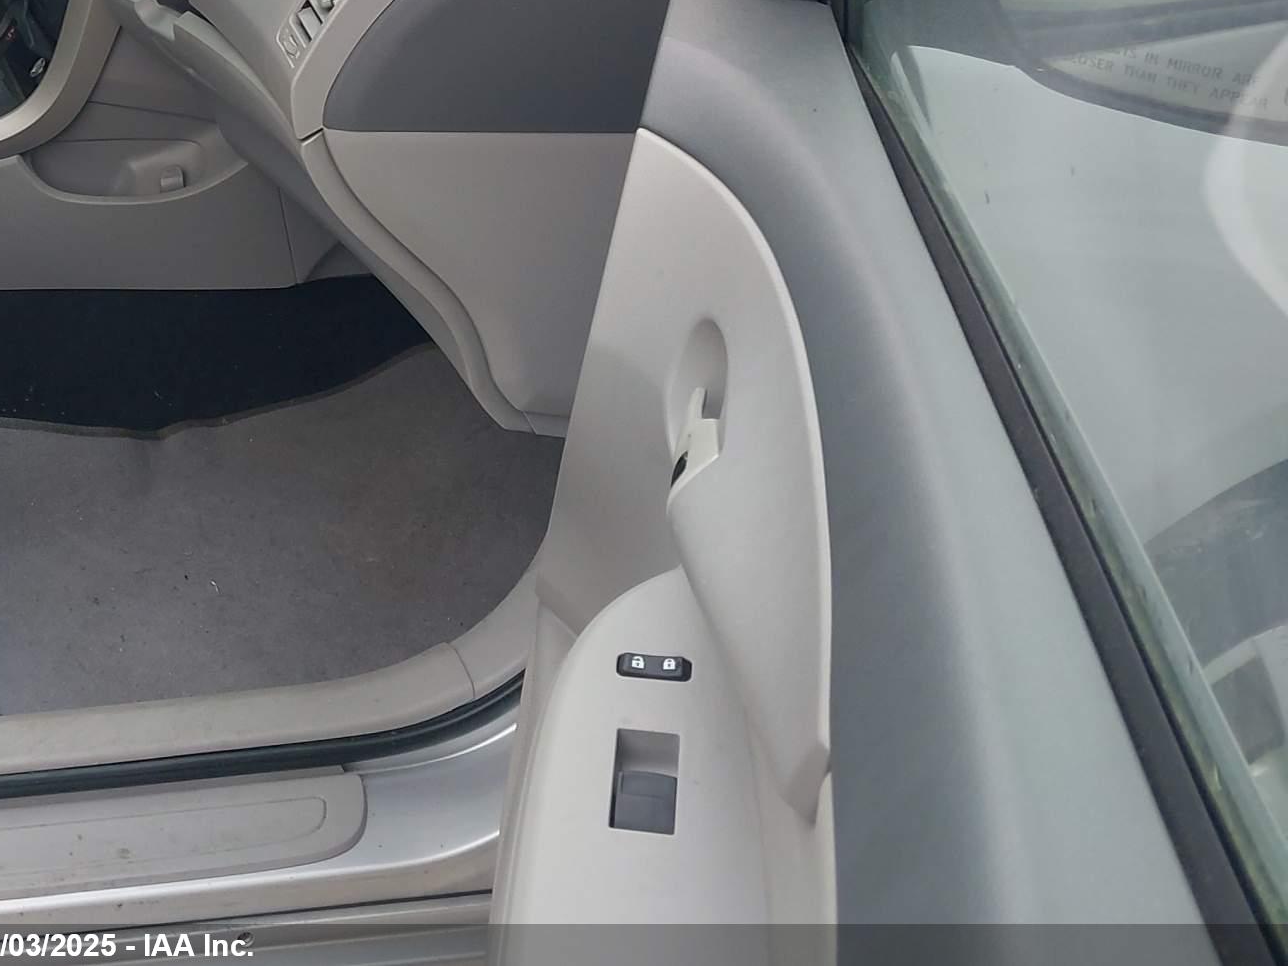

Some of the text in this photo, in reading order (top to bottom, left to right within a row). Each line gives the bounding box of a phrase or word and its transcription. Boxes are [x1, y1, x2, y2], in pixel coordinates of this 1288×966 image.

[1123, 64, 1158, 85] THAN
[1167, 76, 1200, 95] THEY
[1144, 50, 1159, 66] IN
[1166, 57, 1223, 81] MIRROR
